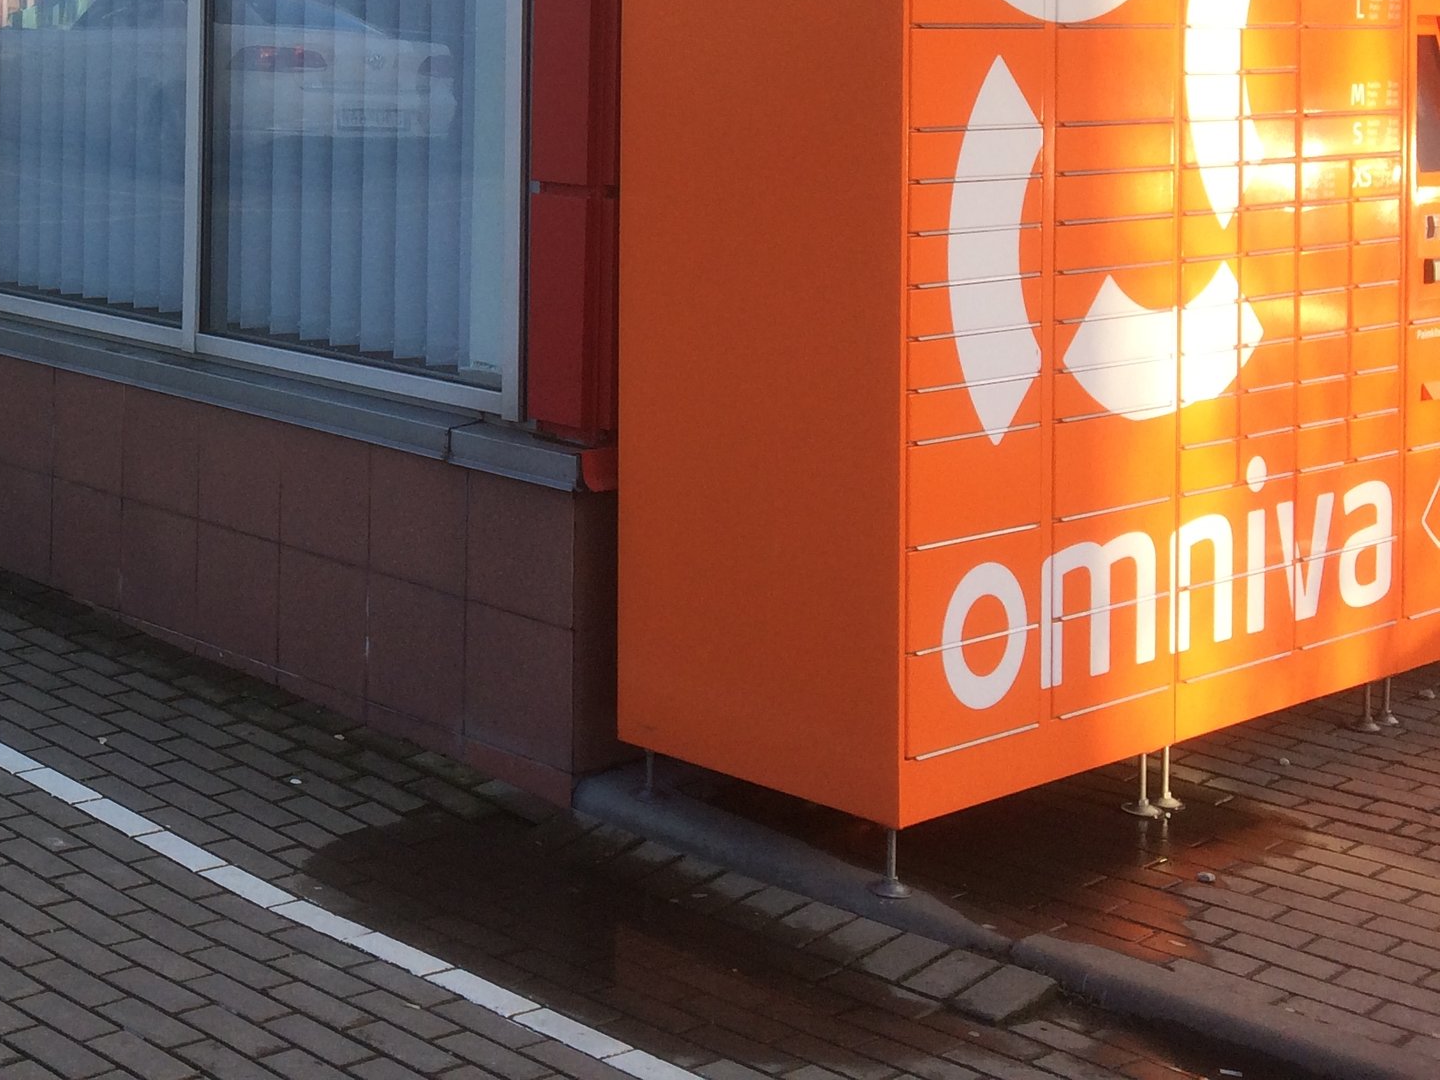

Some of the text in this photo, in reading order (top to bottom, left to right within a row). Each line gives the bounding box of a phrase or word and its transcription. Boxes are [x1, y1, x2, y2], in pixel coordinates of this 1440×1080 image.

[1350, 82, 1365, 106] M
[1353, 121, 1363, 145] S
[941, 455, 1393, 711] omniva
